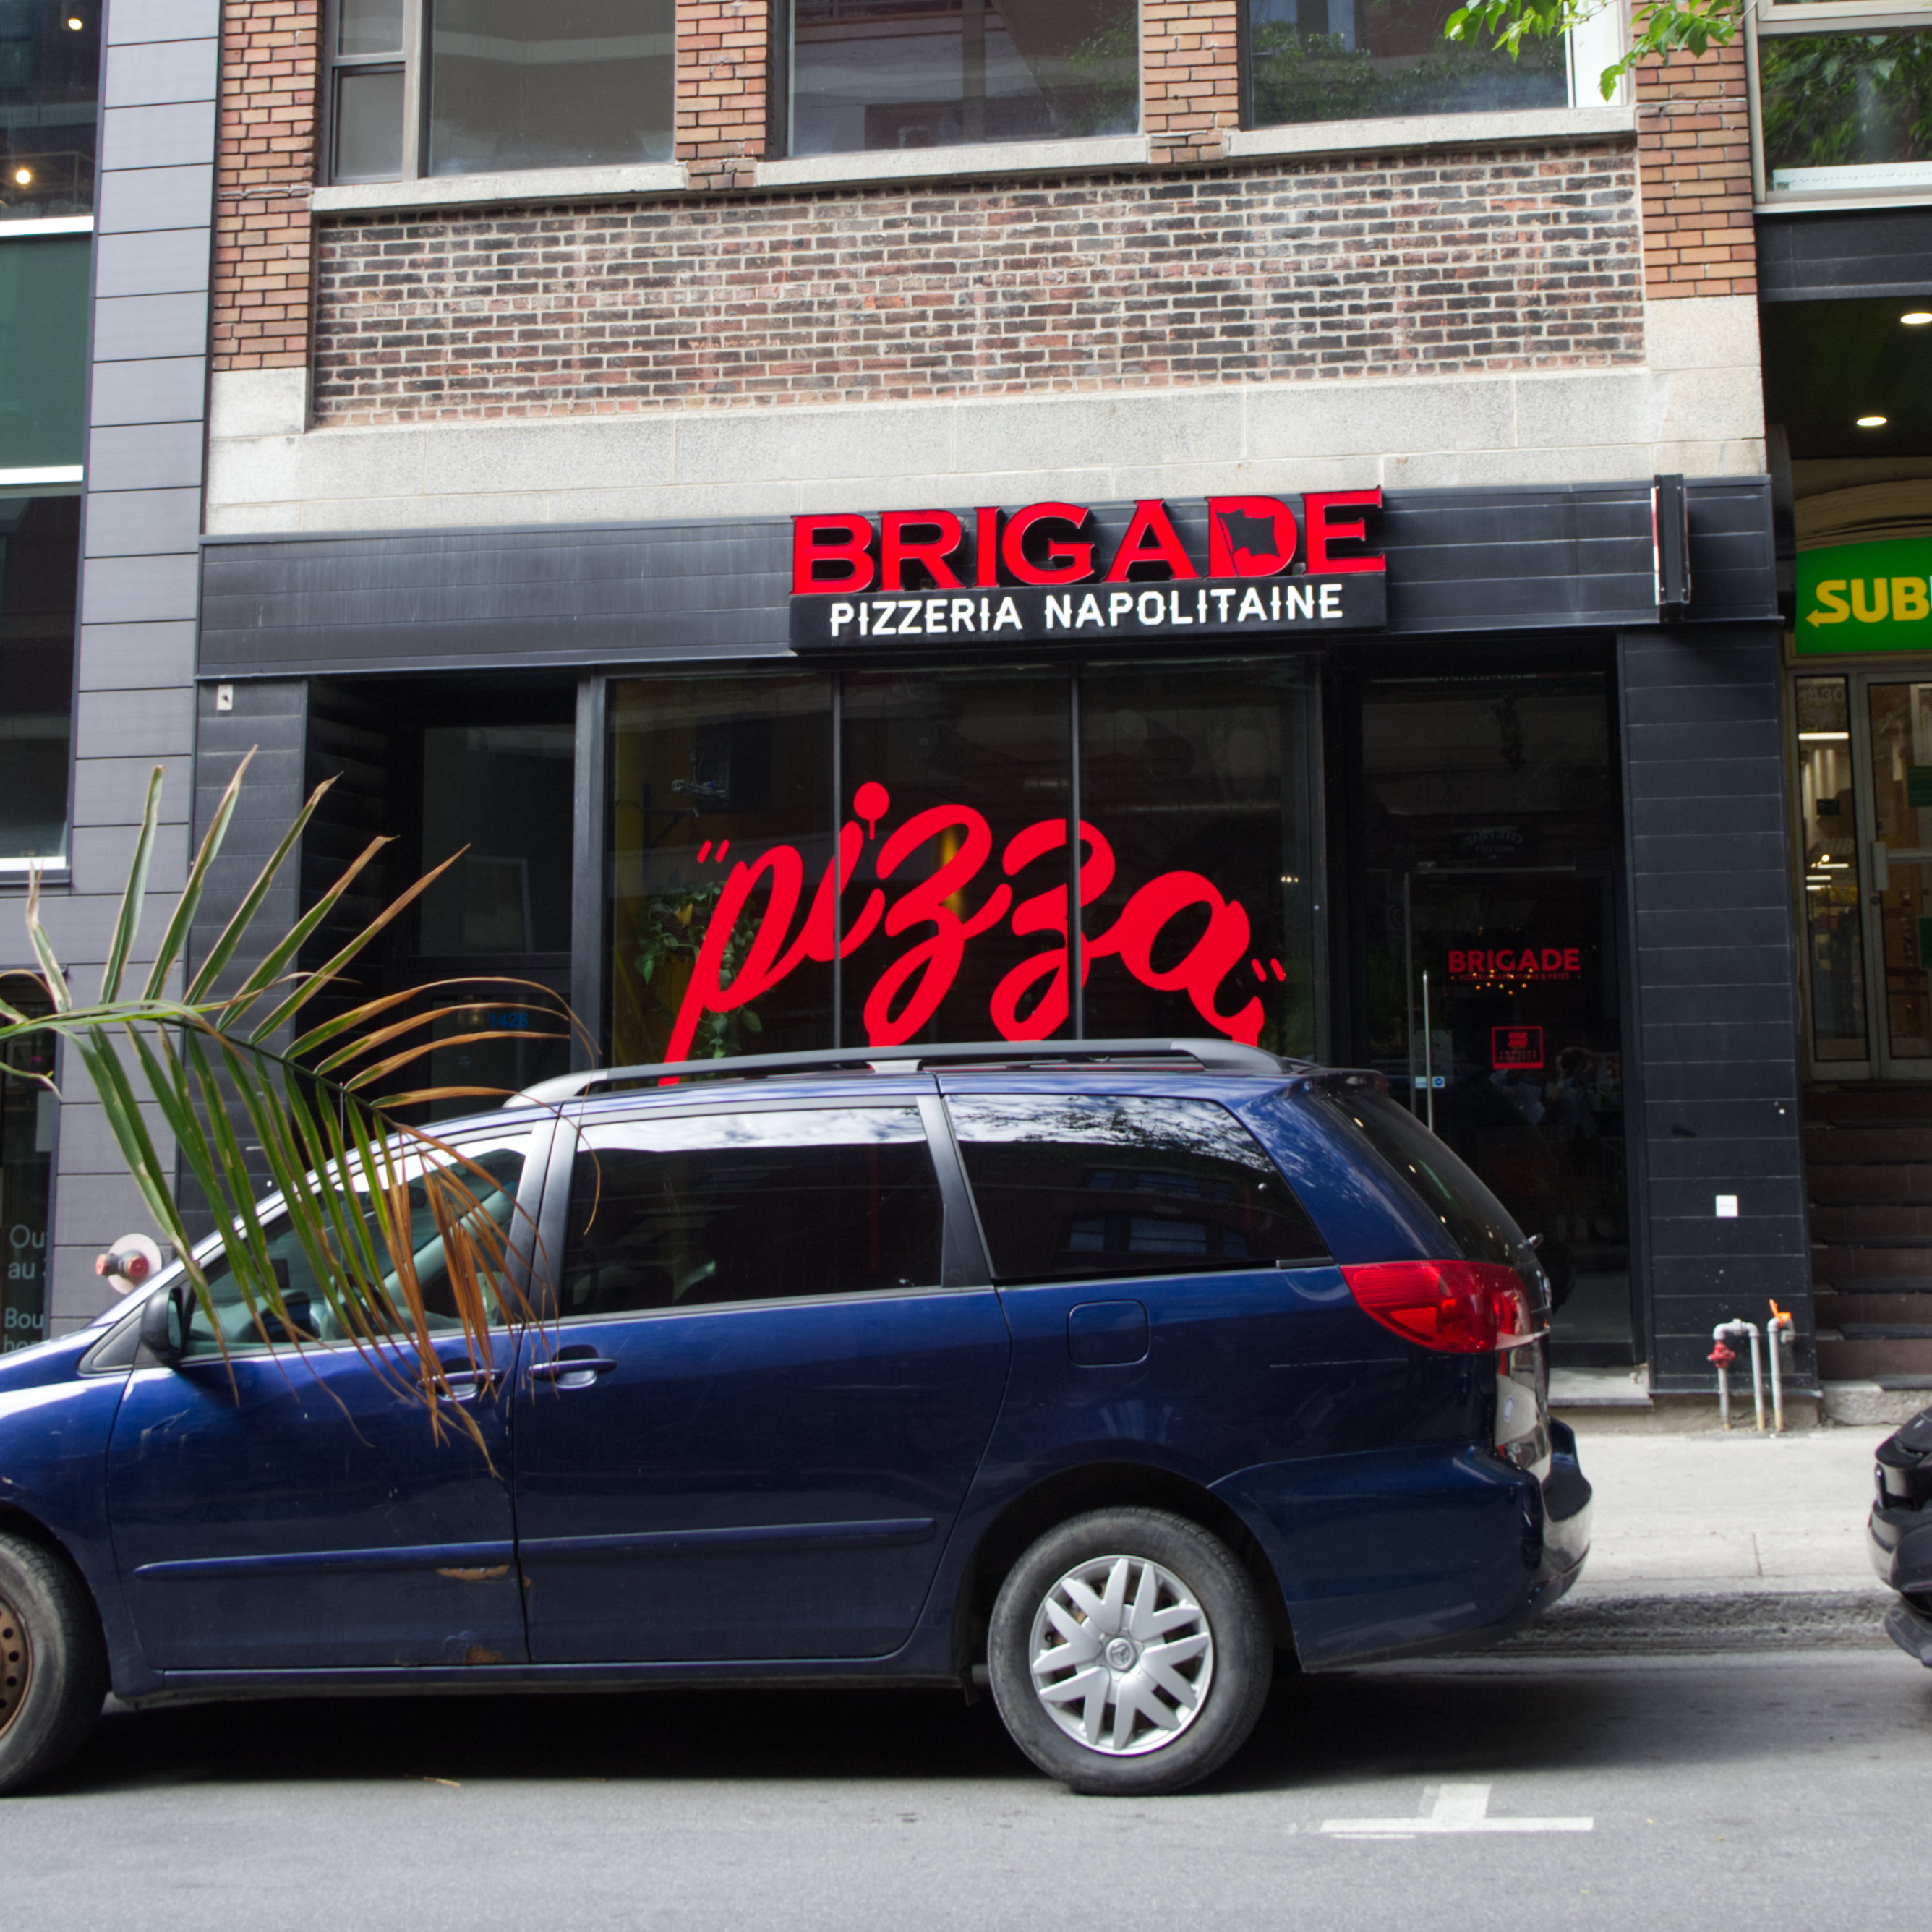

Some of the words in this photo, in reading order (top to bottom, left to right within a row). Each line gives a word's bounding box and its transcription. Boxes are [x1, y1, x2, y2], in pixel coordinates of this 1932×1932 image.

[790, 486, 1386, 596] BRIGADE
[829, 596, 1024, 638] PIZZERIA
[1045, 583, 1343, 629] NAPOLITAINE
[1805, 576, 1932, 628] SUB
[1448, 948, 1581, 973] BRIGADE
[490, 1012, 529, 1028] 1426
[8, 1262, 35, 1280] au
